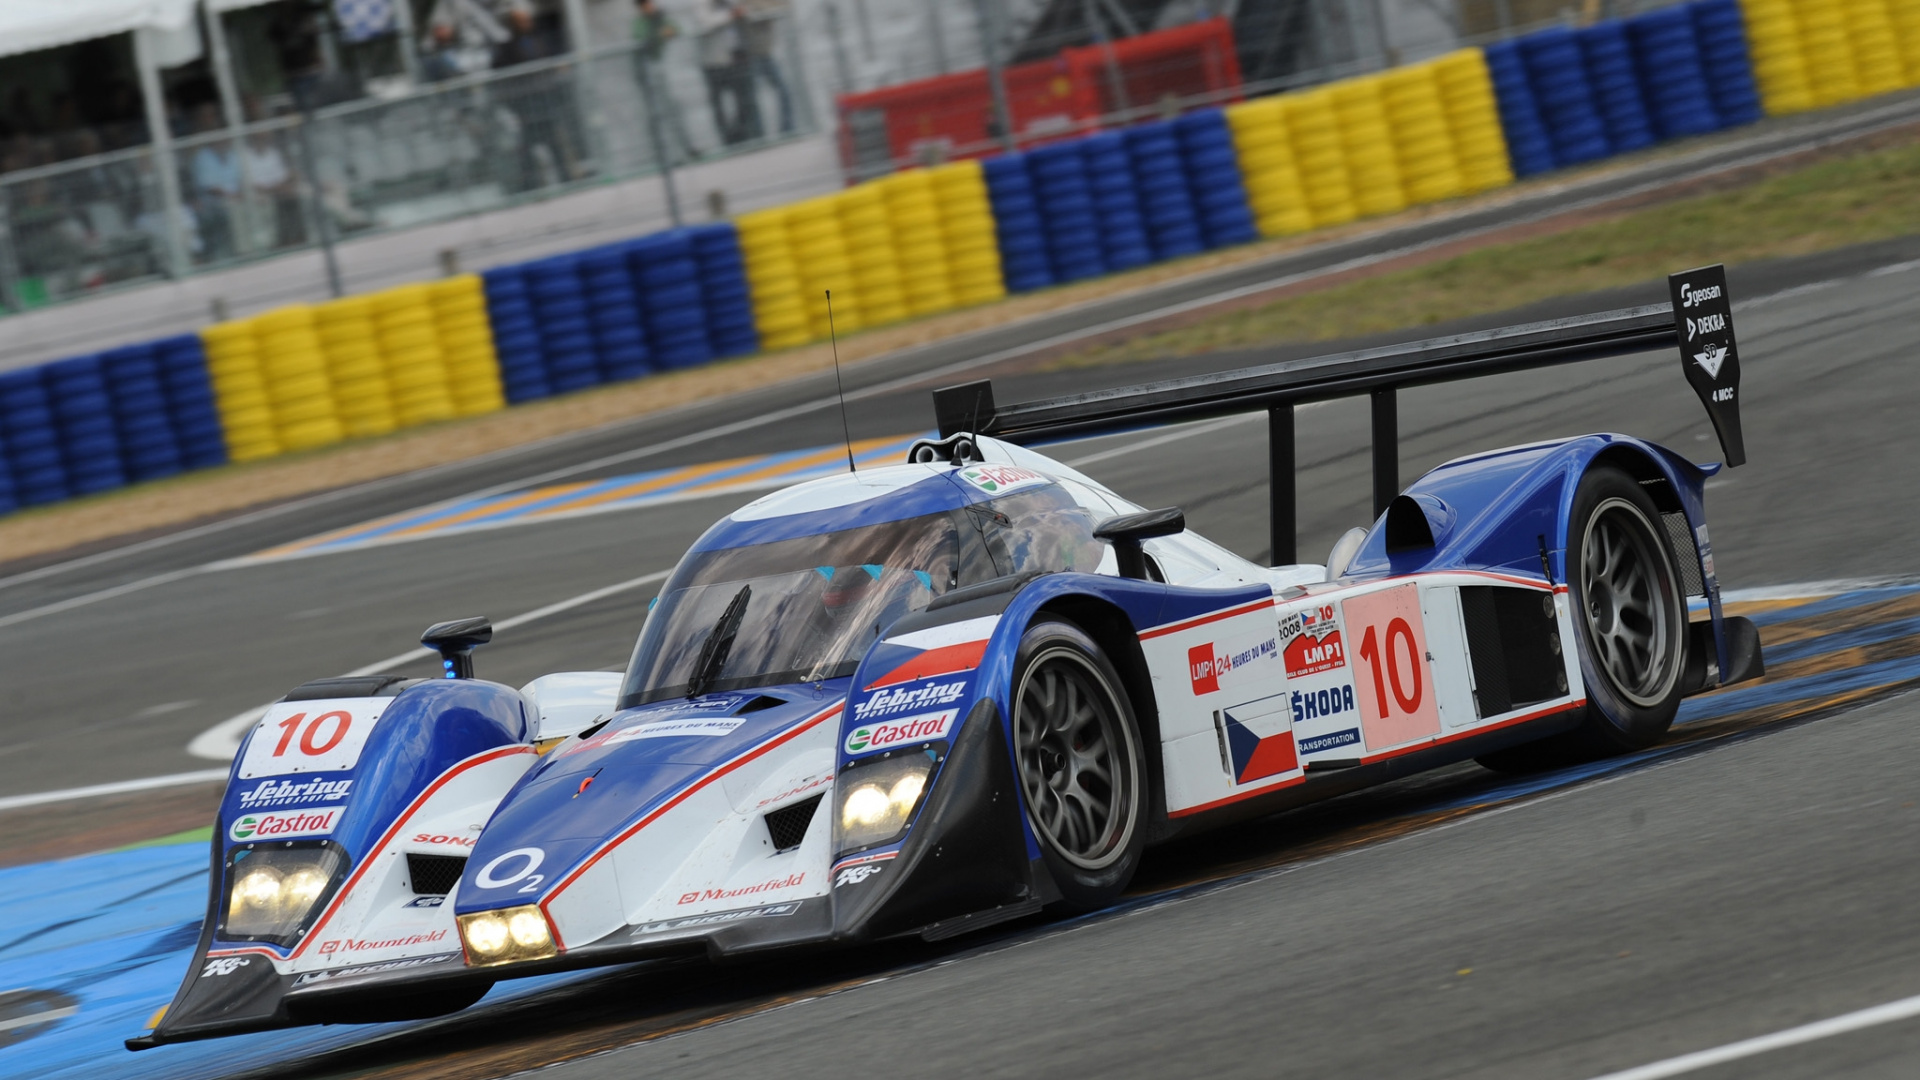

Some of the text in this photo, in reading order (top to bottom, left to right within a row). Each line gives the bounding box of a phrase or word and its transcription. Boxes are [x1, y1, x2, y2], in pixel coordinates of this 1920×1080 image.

[1692, 285, 1721, 307] geosan
[1697, 313, 1725, 335] DEKRA
[1712, 387, 1734, 402] 4 MCC
[980, 465, 1041, 486] Castrol
[1318, 605, 1333, 621] 10
[1192, 638, 1276, 681] LMP1 24 HEURES DU MANS
[1303, 642, 1341, 665] LMP1
[1360, 617, 1423, 719] 10
[853, 681, 968, 714] Sebring
[1290, 684, 1355, 723] ŠKODA
[272, 710, 352, 757] 10
[871, 714, 948, 746] Castrol
[240, 777, 354, 802] Sebring
[256, 810, 335, 835] Castrol
[700, 872, 806, 902] Mountfield
[676, 904, 792, 927] MICHELIN
[341, 929, 448, 952] Mountfield
[335, 955, 451, 976] MICHELIN
